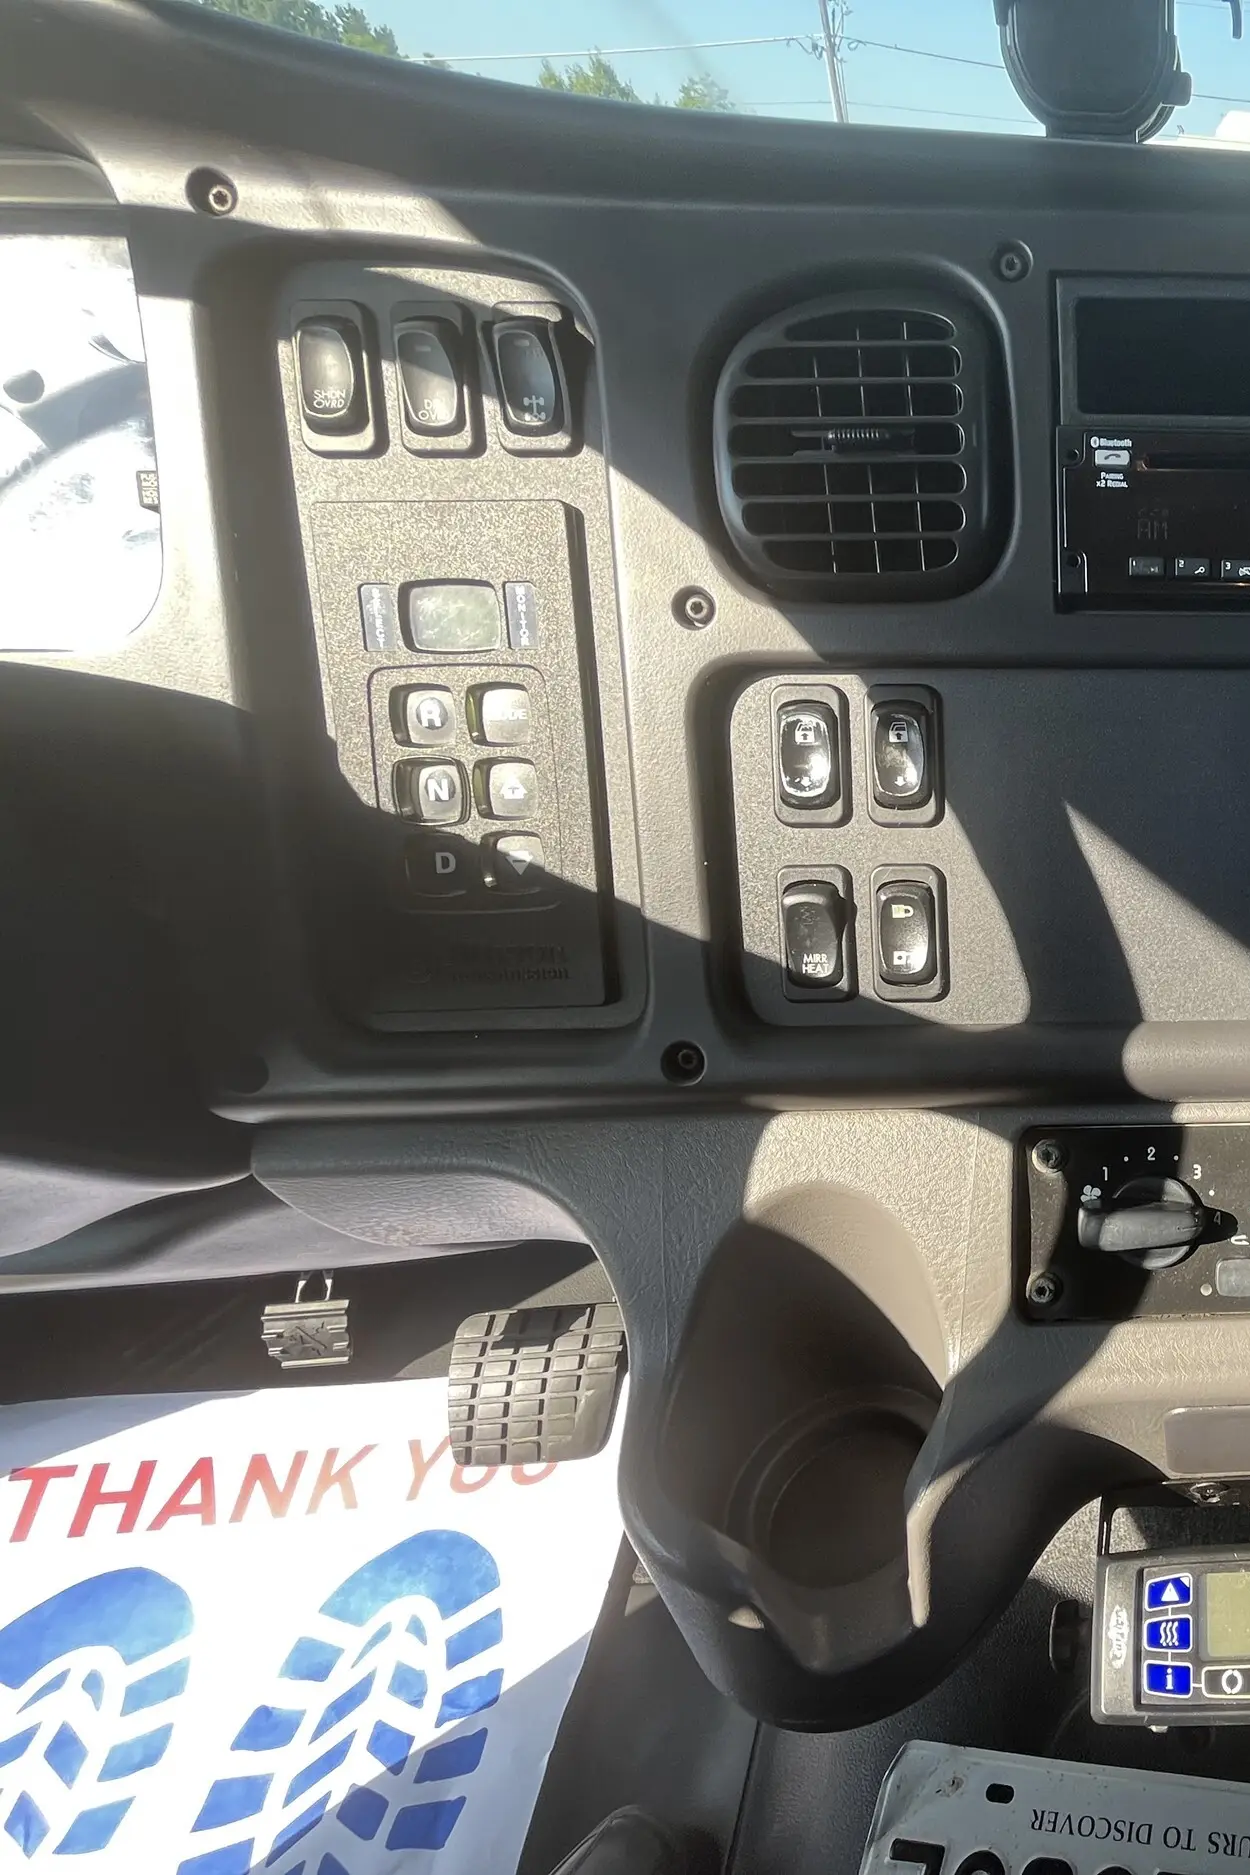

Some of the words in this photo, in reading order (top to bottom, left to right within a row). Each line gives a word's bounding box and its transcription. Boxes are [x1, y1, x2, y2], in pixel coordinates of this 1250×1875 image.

[313, 389, 346, 400] SHDN
[313, 398, 345, 409] OVRD
[418, 409, 451, 421] OV
[1099, 438, 1133, 447] Bluetooth
[514, 586, 530, 646] MONITOR
[420, 703, 442, 727] R
[427, 778, 450, 802] N
[435, 851, 457, 874] D
[802, 953, 828, 963] MIRR
[801, 963, 829, 974] HEAT
[1147, 1146, 1156, 1161] 2
[1102, 1166, 1108, 1181] 1
[1192, 1163, 1202, 1180] 3
[1213, 1211, 1221, 1226] 4
[8, 1443, 378, 1544] THANK
[1028, 1807, 1154, 1845] DISCOVER
[1161, 1825, 1197, 1851] TO
